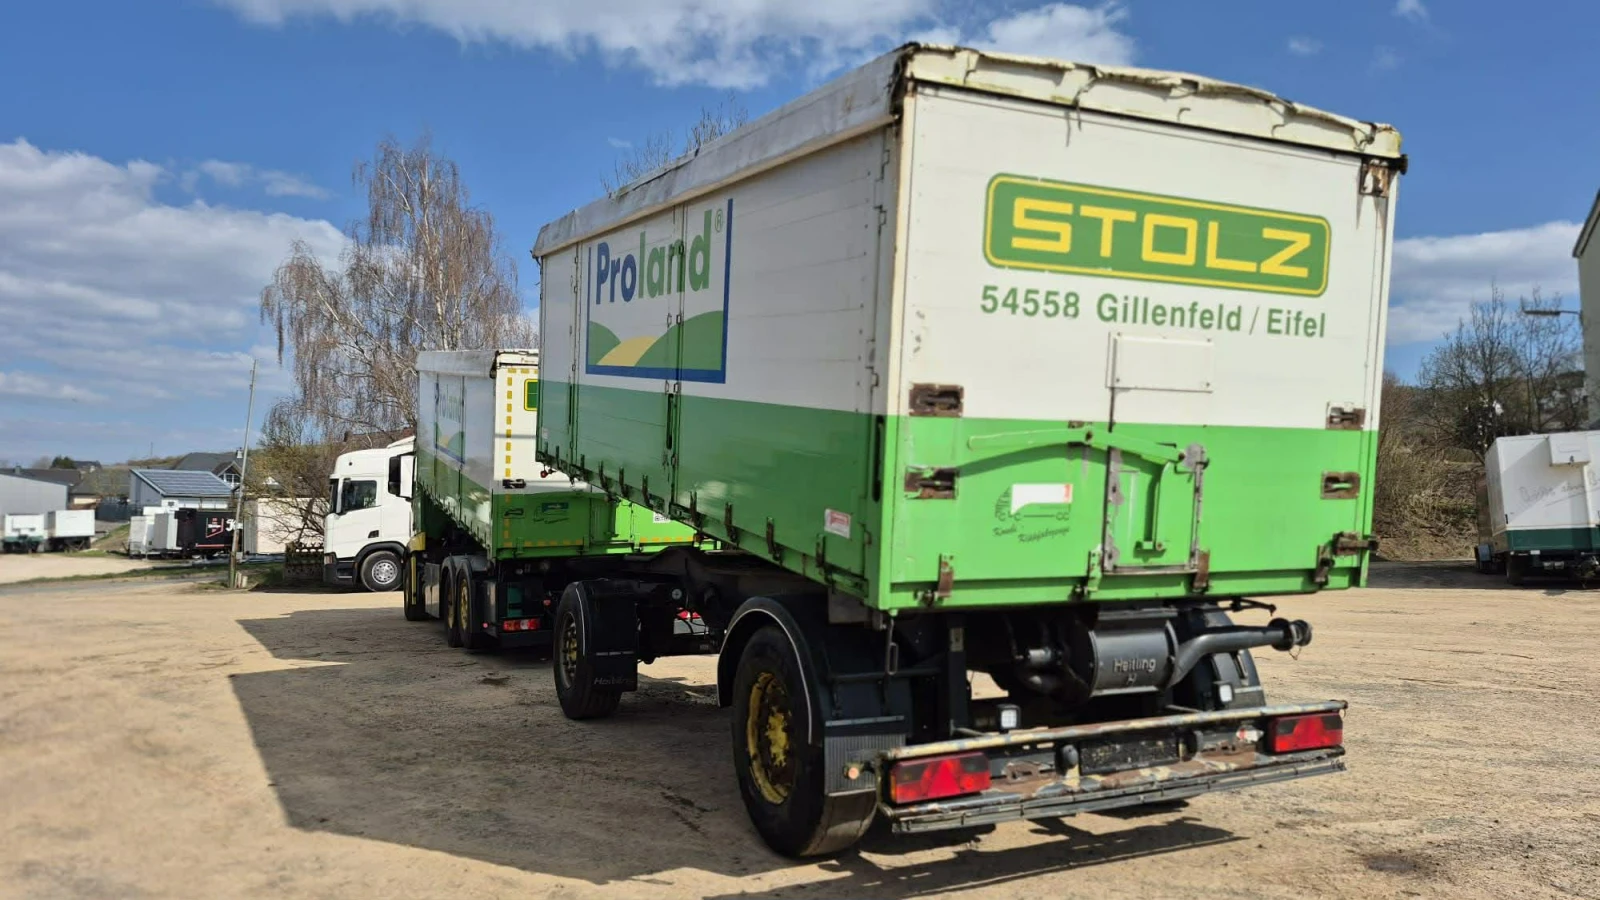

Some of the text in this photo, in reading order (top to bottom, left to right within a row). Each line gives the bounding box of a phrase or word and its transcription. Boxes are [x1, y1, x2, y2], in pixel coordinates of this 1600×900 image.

[1011, 197, 1312, 279] STOLZ
[980, 285, 1081, 320] 54558
[1096, 293, 1242, 332] Gillenfeld
[1266, 308, 1327, 338] Eifel
